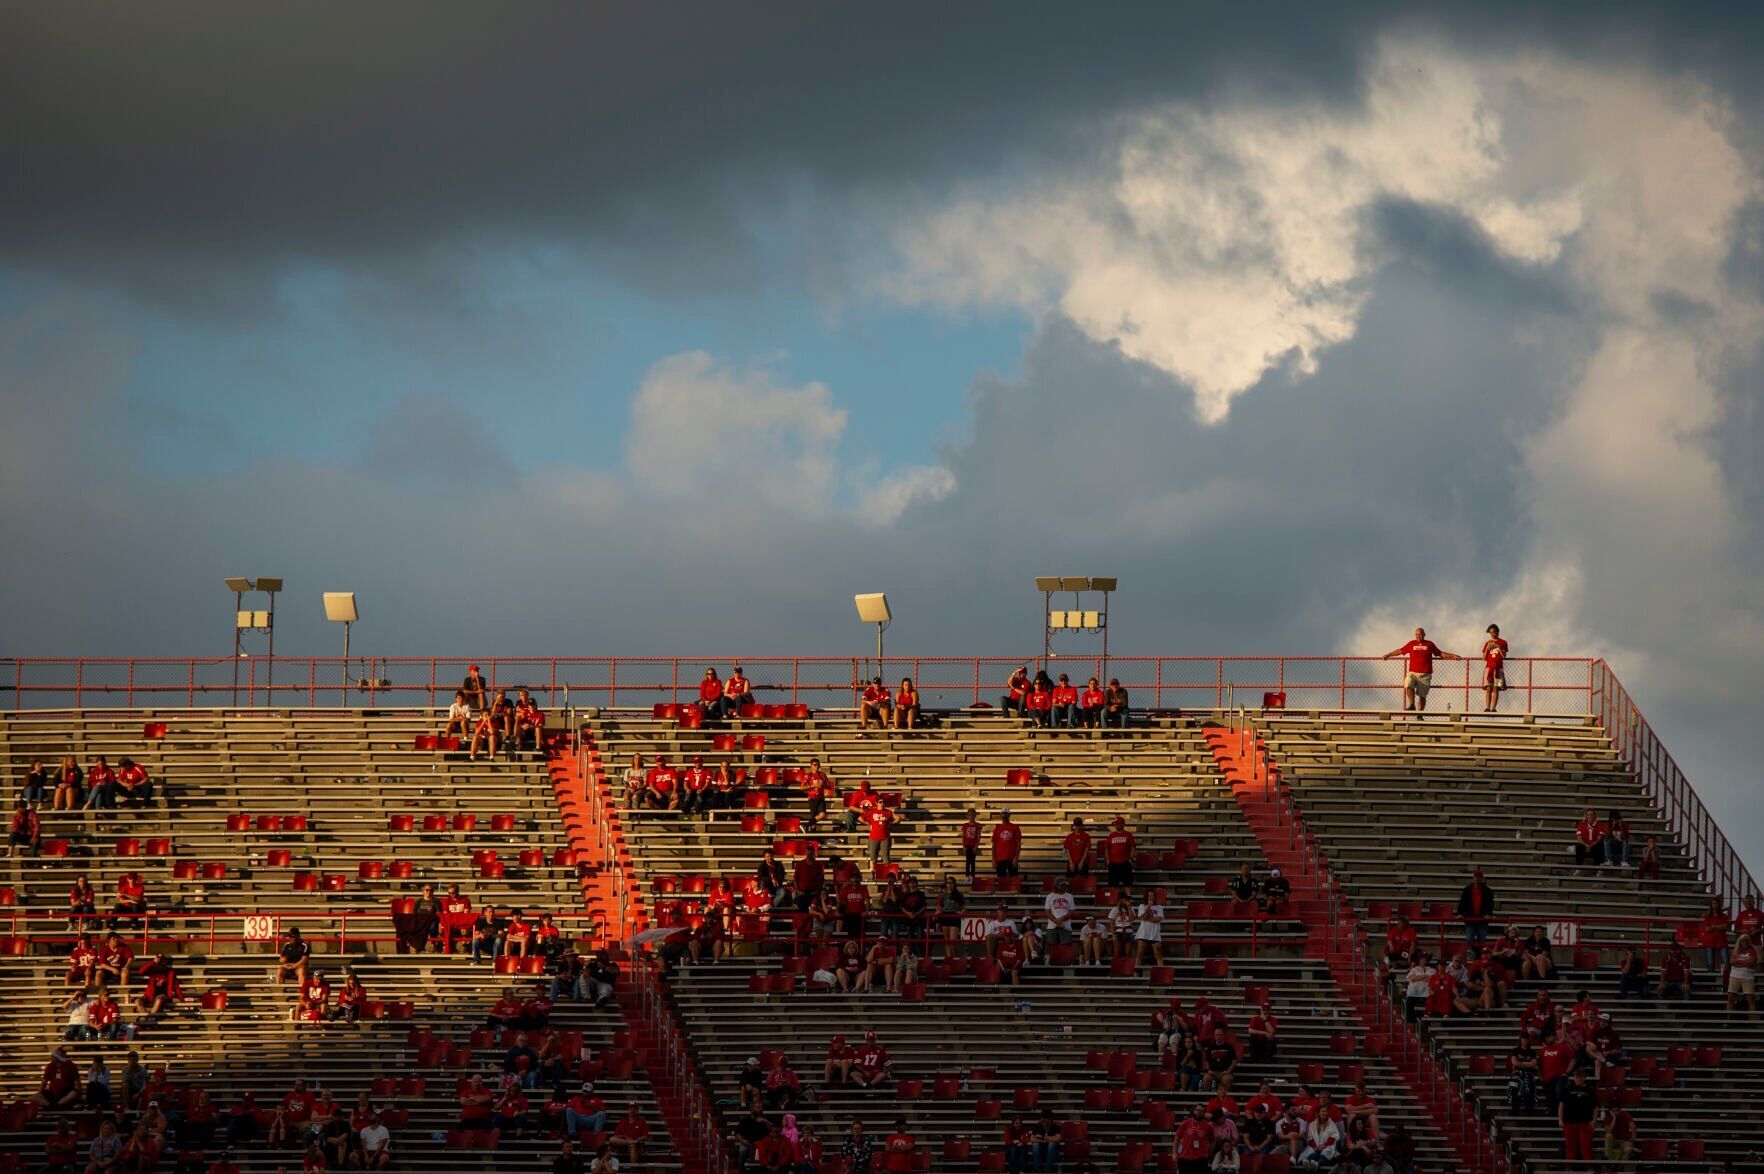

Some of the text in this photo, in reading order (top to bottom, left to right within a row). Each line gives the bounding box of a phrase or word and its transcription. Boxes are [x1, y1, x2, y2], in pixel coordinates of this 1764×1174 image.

[248, 917, 269, 939] 39
[964, 918, 986, 940] 40
[1552, 923, 1571, 945] 41
[864, 1054, 878, 1066] 17
